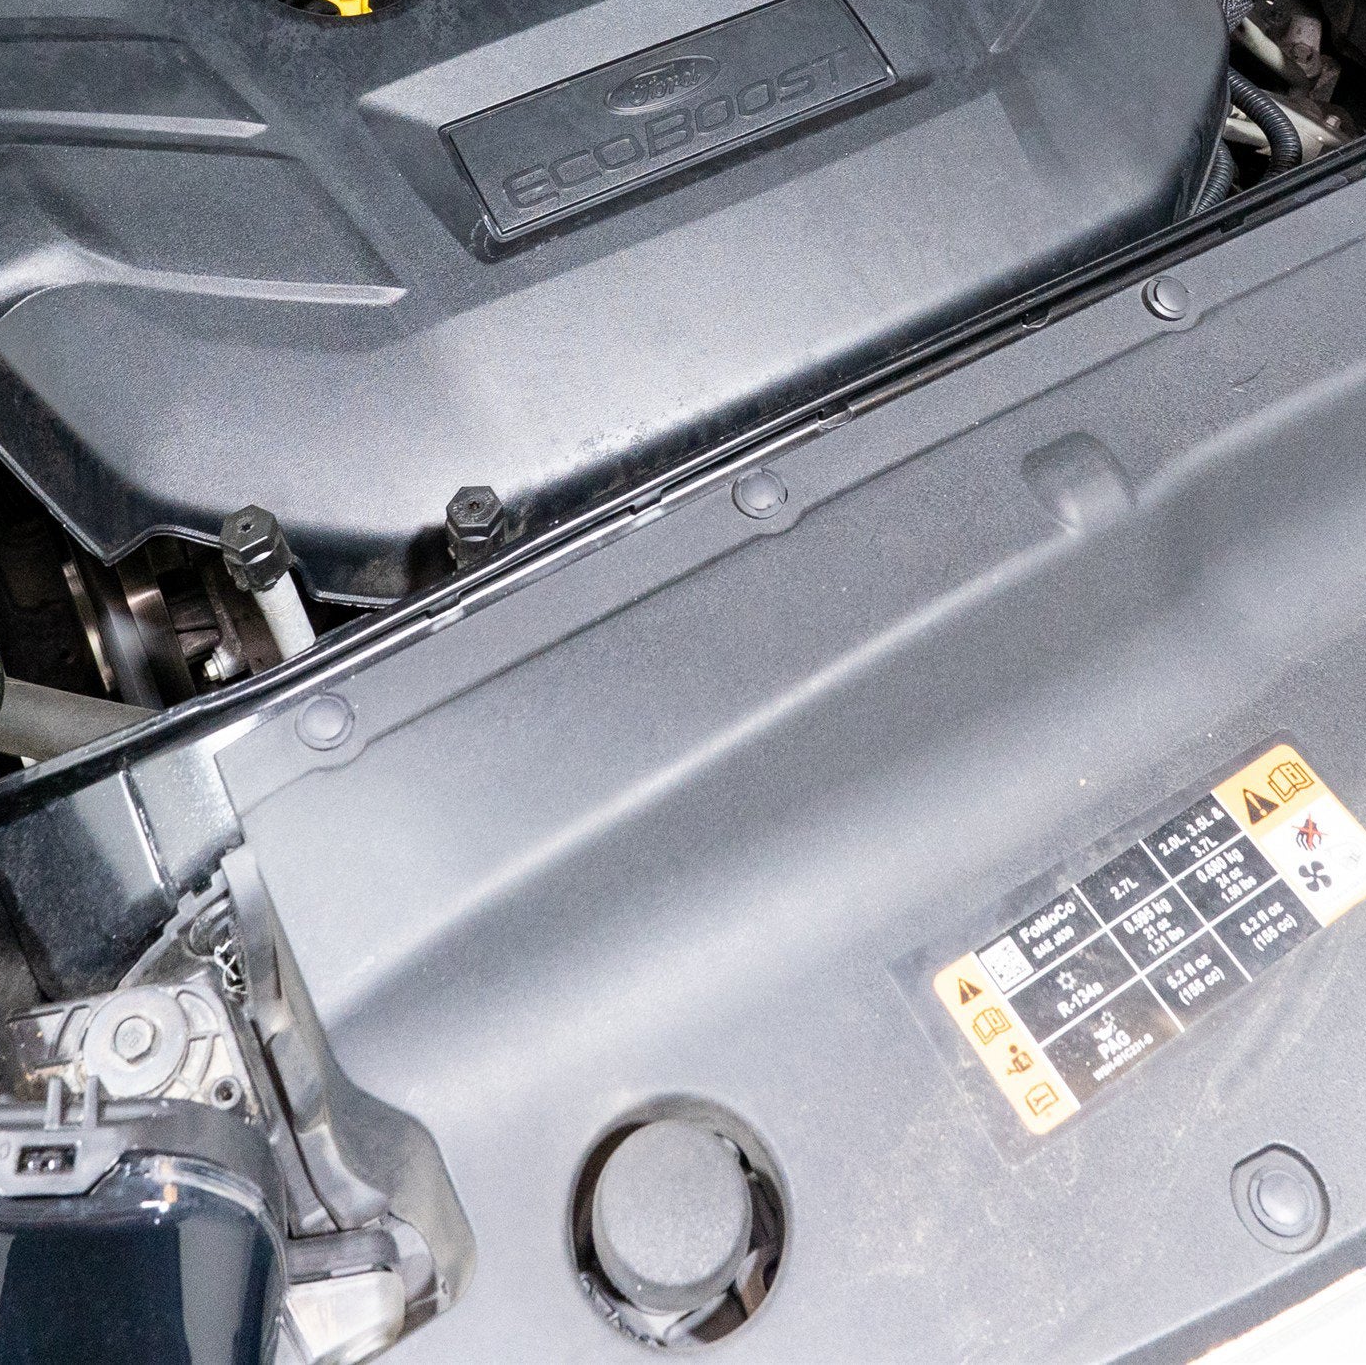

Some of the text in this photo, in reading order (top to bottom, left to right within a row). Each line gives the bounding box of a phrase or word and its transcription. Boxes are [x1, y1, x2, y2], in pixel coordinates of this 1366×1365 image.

[1158, 806, 1225, 856] 2.0L, 3.5L &
[1189, 836, 1219, 857] 3.7L
[1195, 847, 1244, 883] 0.680 kg
[1214, 866, 1243, 889] 24 oz
[1109, 876, 1139, 900] 2.7L
[1237, 875, 1257, 891] lbs
[1018, 900, 1076, 944] FoMoCo
[1122, 897, 1172, 934] 0.595 kg
[1142, 917, 1171, 940] 21 oz
[1239, 901, 1284, 935] 5.2 fl oz
[1031, 938, 1055, 959] SAE
[1147, 926, 1185, 955] 1.31 lbs
[1166, 953, 1212, 989] 5.2 fl oz
[1056, 981, 1104, 1018] R-134a
[1096, 1029, 1134, 1061] PAG
